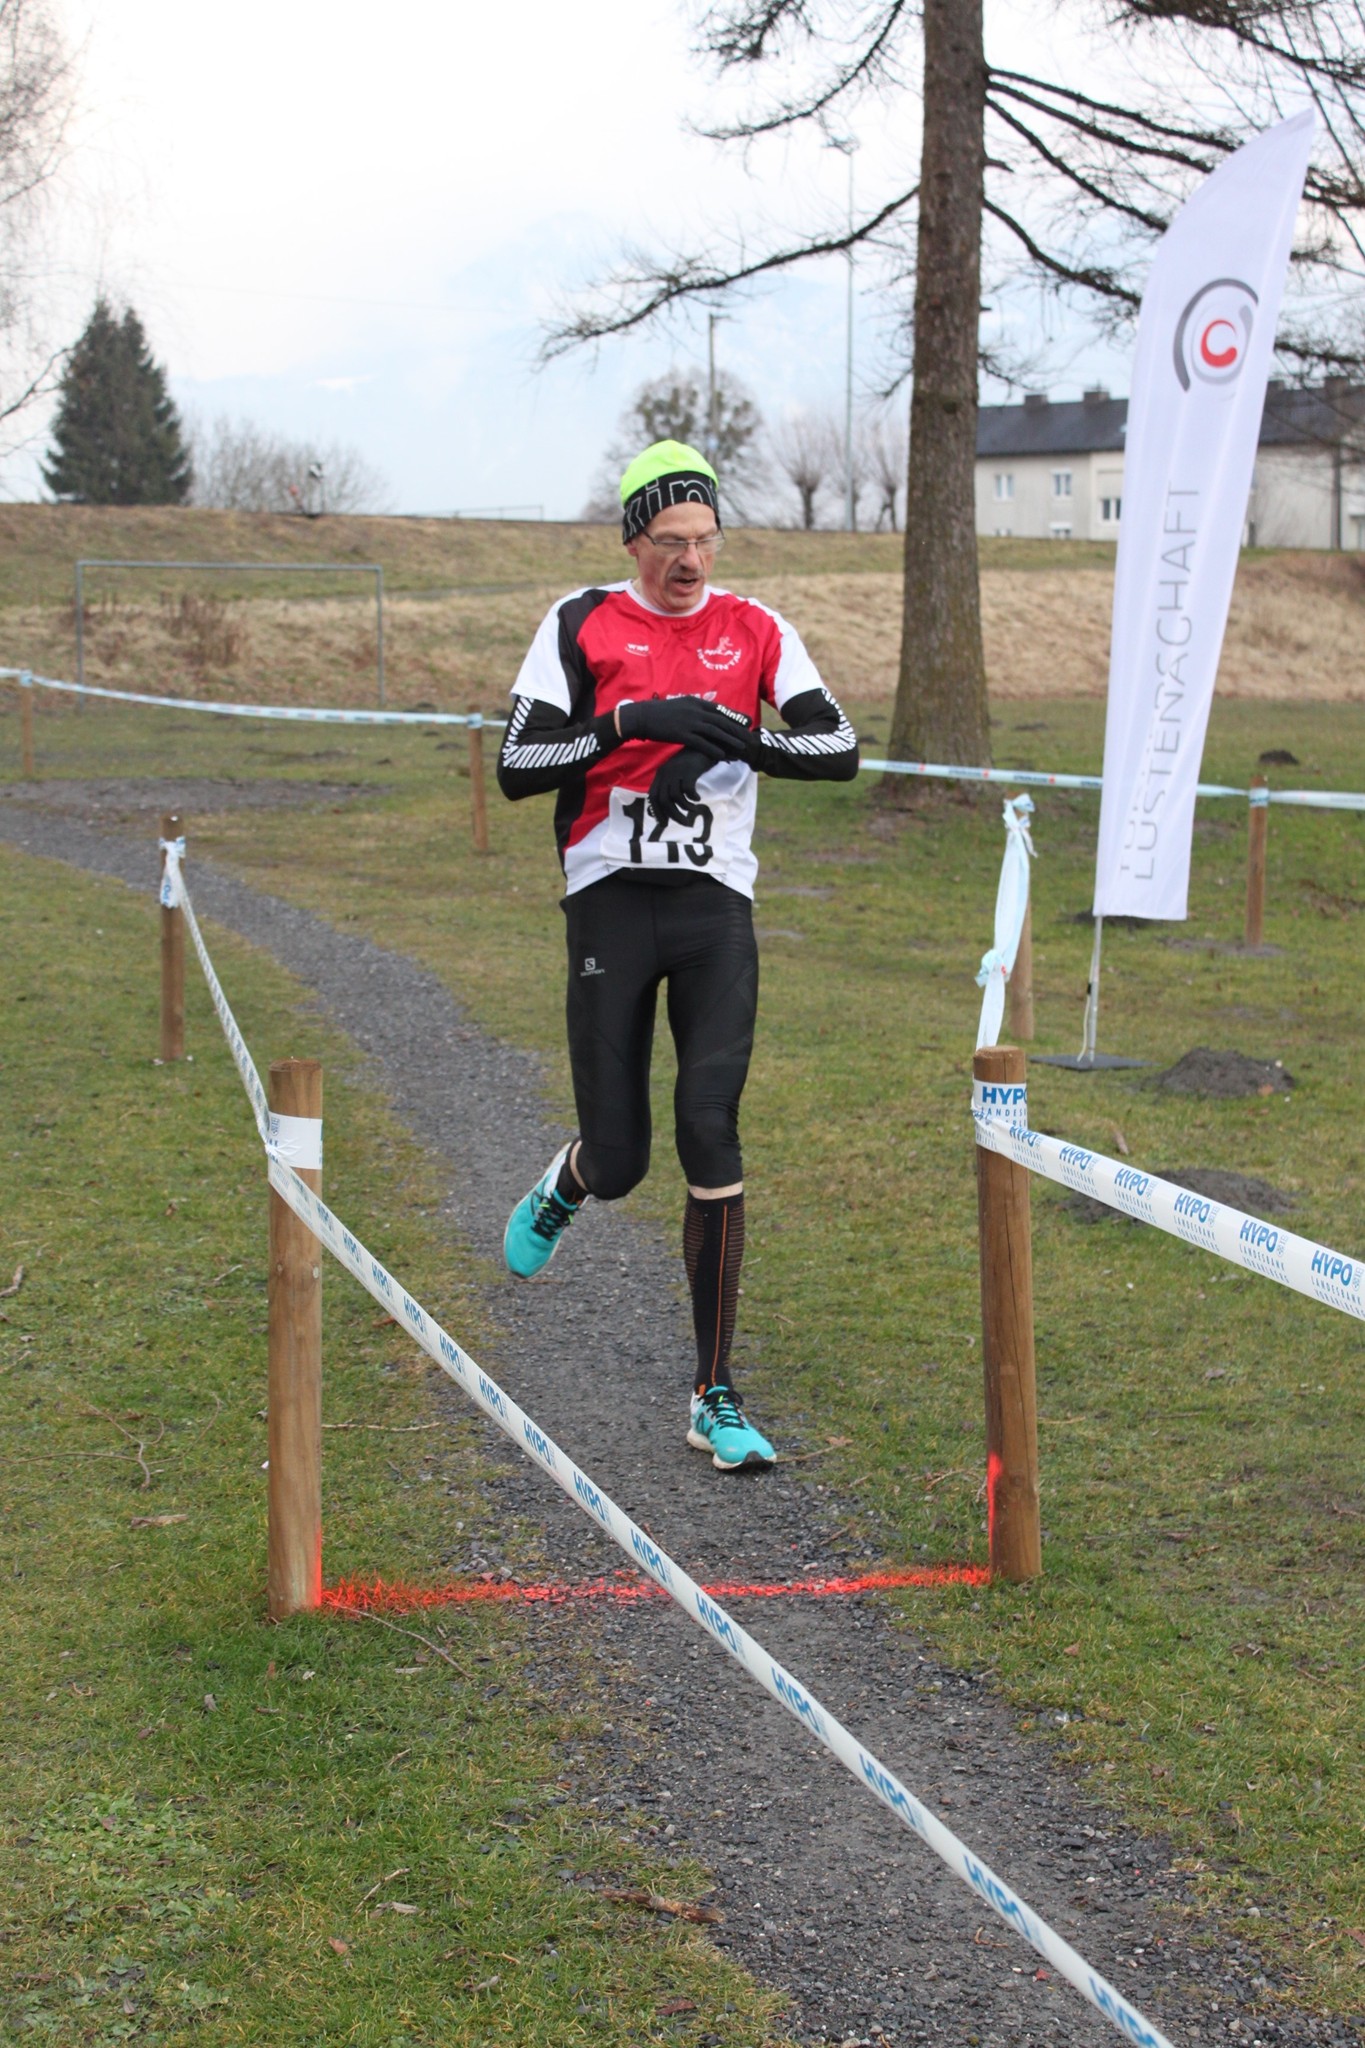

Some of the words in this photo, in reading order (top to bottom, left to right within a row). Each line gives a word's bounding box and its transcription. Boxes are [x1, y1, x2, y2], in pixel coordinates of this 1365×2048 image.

[716, 704, 748, 726] skinfit
[981, 1086, 1028, 1105] HYP
[981, 1107, 1027, 1118] LANDES
[1059, 1146, 1093, 1170] HYPO
[1114, 1167, 1149, 1196] HYPO
[1174, 1193, 1211, 1223] HYPO
[1239, 1220, 1279, 1253] HYPO
[1311, 1250, 1353, 1286] HYPO
[479, 1374, 504, 1418] HYPO
[524, 1420, 552, 1466] HYPO
[574, 1471, 606, 1521] HYPO
[631, 1529, 667, 1583] HYPO
[695, 1592, 738, 1653] HYPO
[771, 1667, 821, 1735] HYPO
[859, 1753, 917, 1827] HYPO
[963, 1854, 1033, 1941] HYPO
